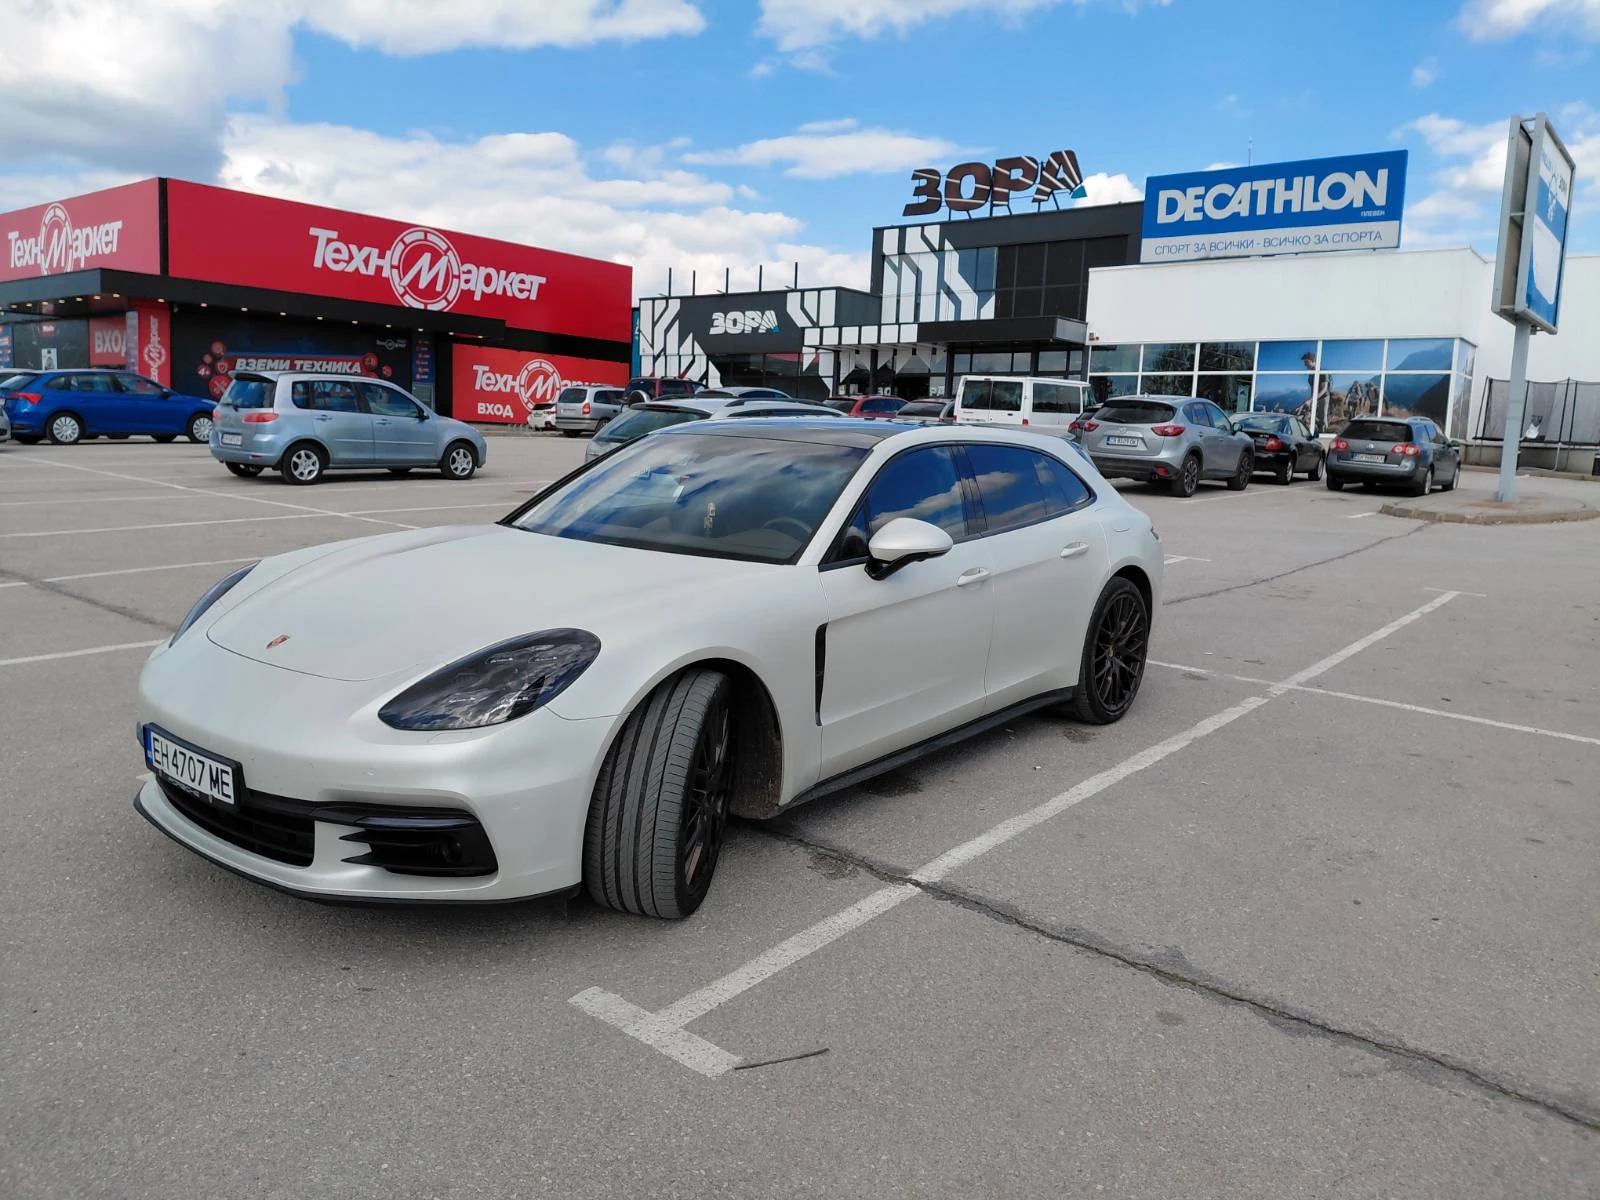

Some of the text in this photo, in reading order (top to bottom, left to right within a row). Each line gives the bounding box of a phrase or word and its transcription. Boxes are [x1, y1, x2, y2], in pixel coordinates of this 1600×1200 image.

[1156, 168, 1389, 224] DECATHLON
[1154, 243, 1191, 256] СПОРТ
[1193, 241, 1208, 253] ЗА
[1209, 238, 1255, 253] ВСИЧКИ
[1263, 234, 1311, 248] ВСИЧКО
[1313, 233, 1329, 245] ЗА
[1331, 230, 1383, 243] СПОРТА
[235, 358, 362, 374] ВЗЕМИ ТЕХНИКА
[477, 402, 514, 418] ВХОД
[171, 748, 205, 786] 4707
